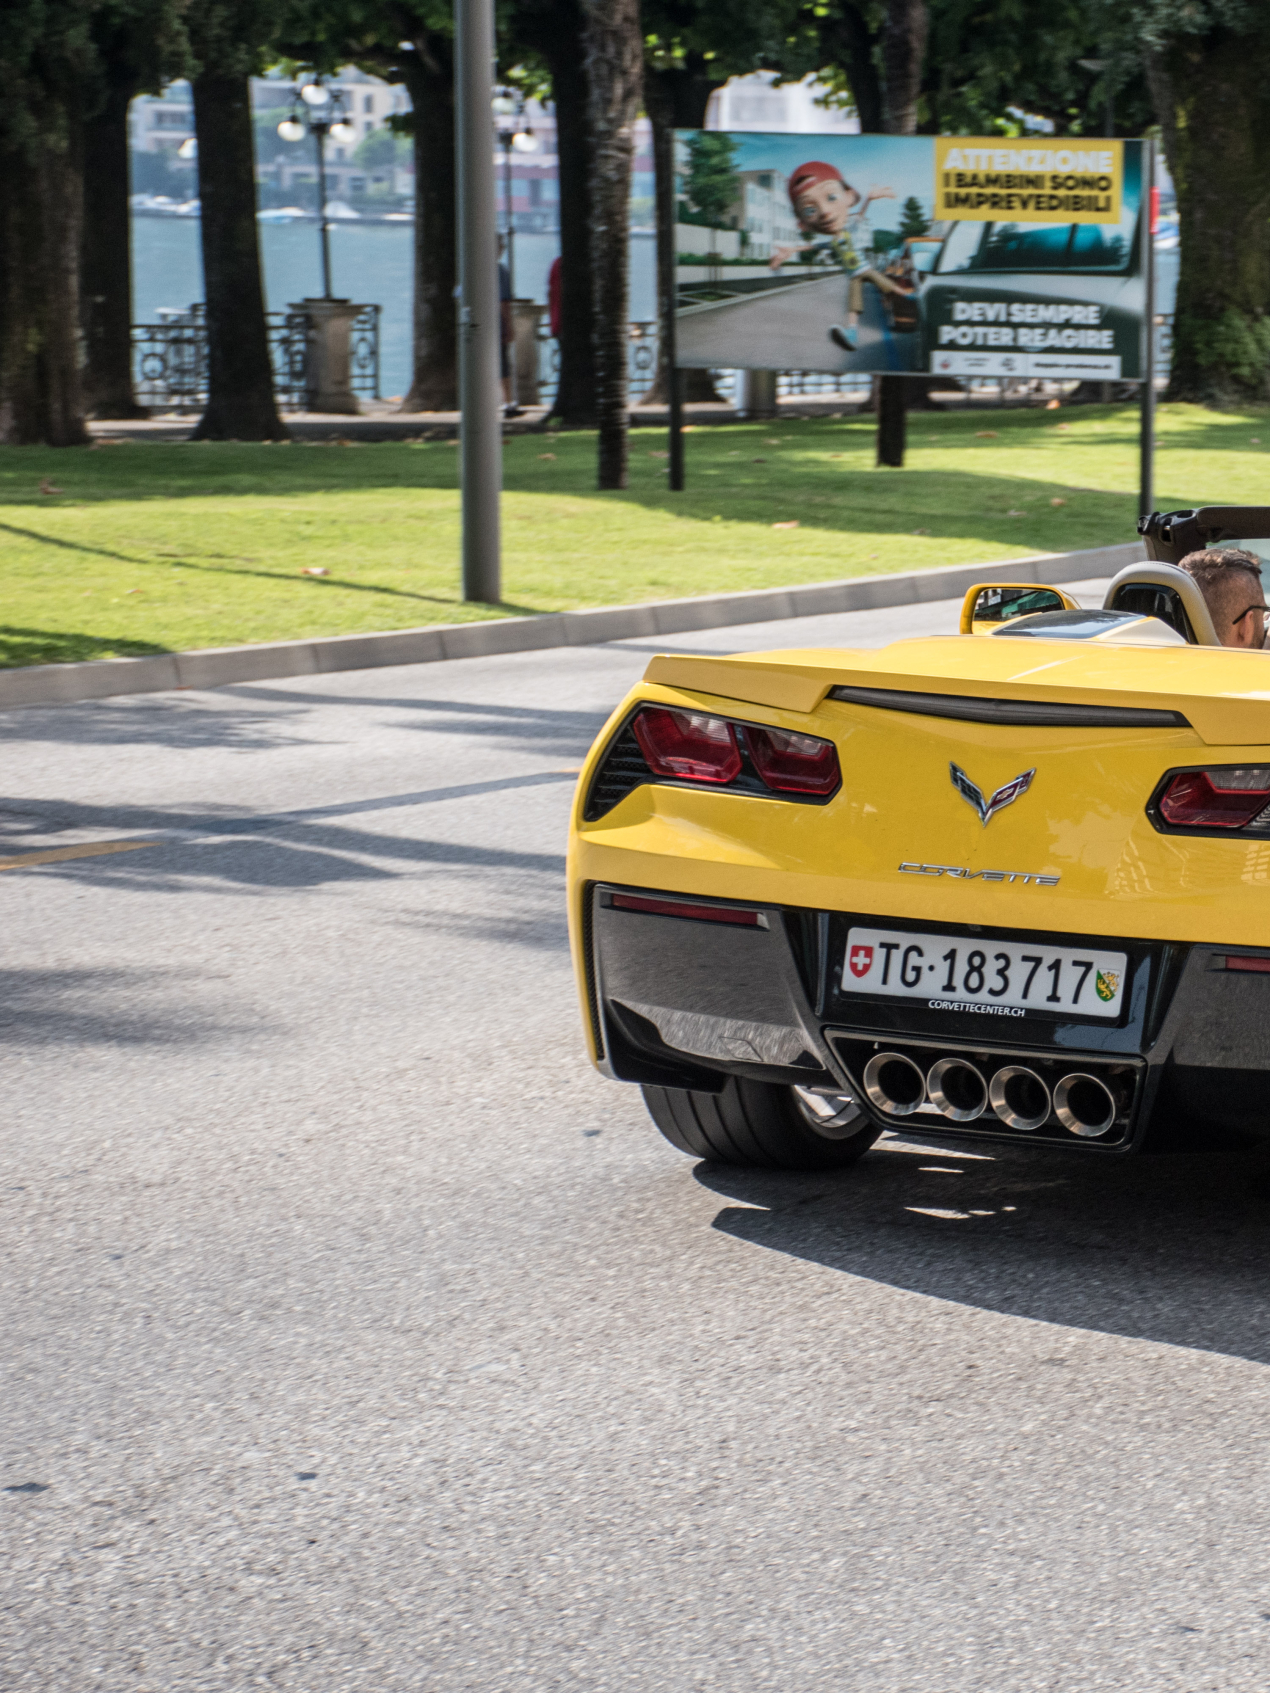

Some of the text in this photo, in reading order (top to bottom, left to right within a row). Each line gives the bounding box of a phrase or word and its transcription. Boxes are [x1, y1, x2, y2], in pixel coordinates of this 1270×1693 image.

[943, 148, 1114, 173] ATTENZIONE
[943, 172, 1113, 192] I BAMBINI SONO
[944, 191, 1112, 212] IMPREVEDIBILI
[953, 302, 1101, 325] DEVI SEMPRE
[938, 325, 1115, 349] POTER REAGIRE
[898, 862, 1061, 886] CORVETTE
[928, 1000, 1025, 1018] CORVETTECENTER.CH
